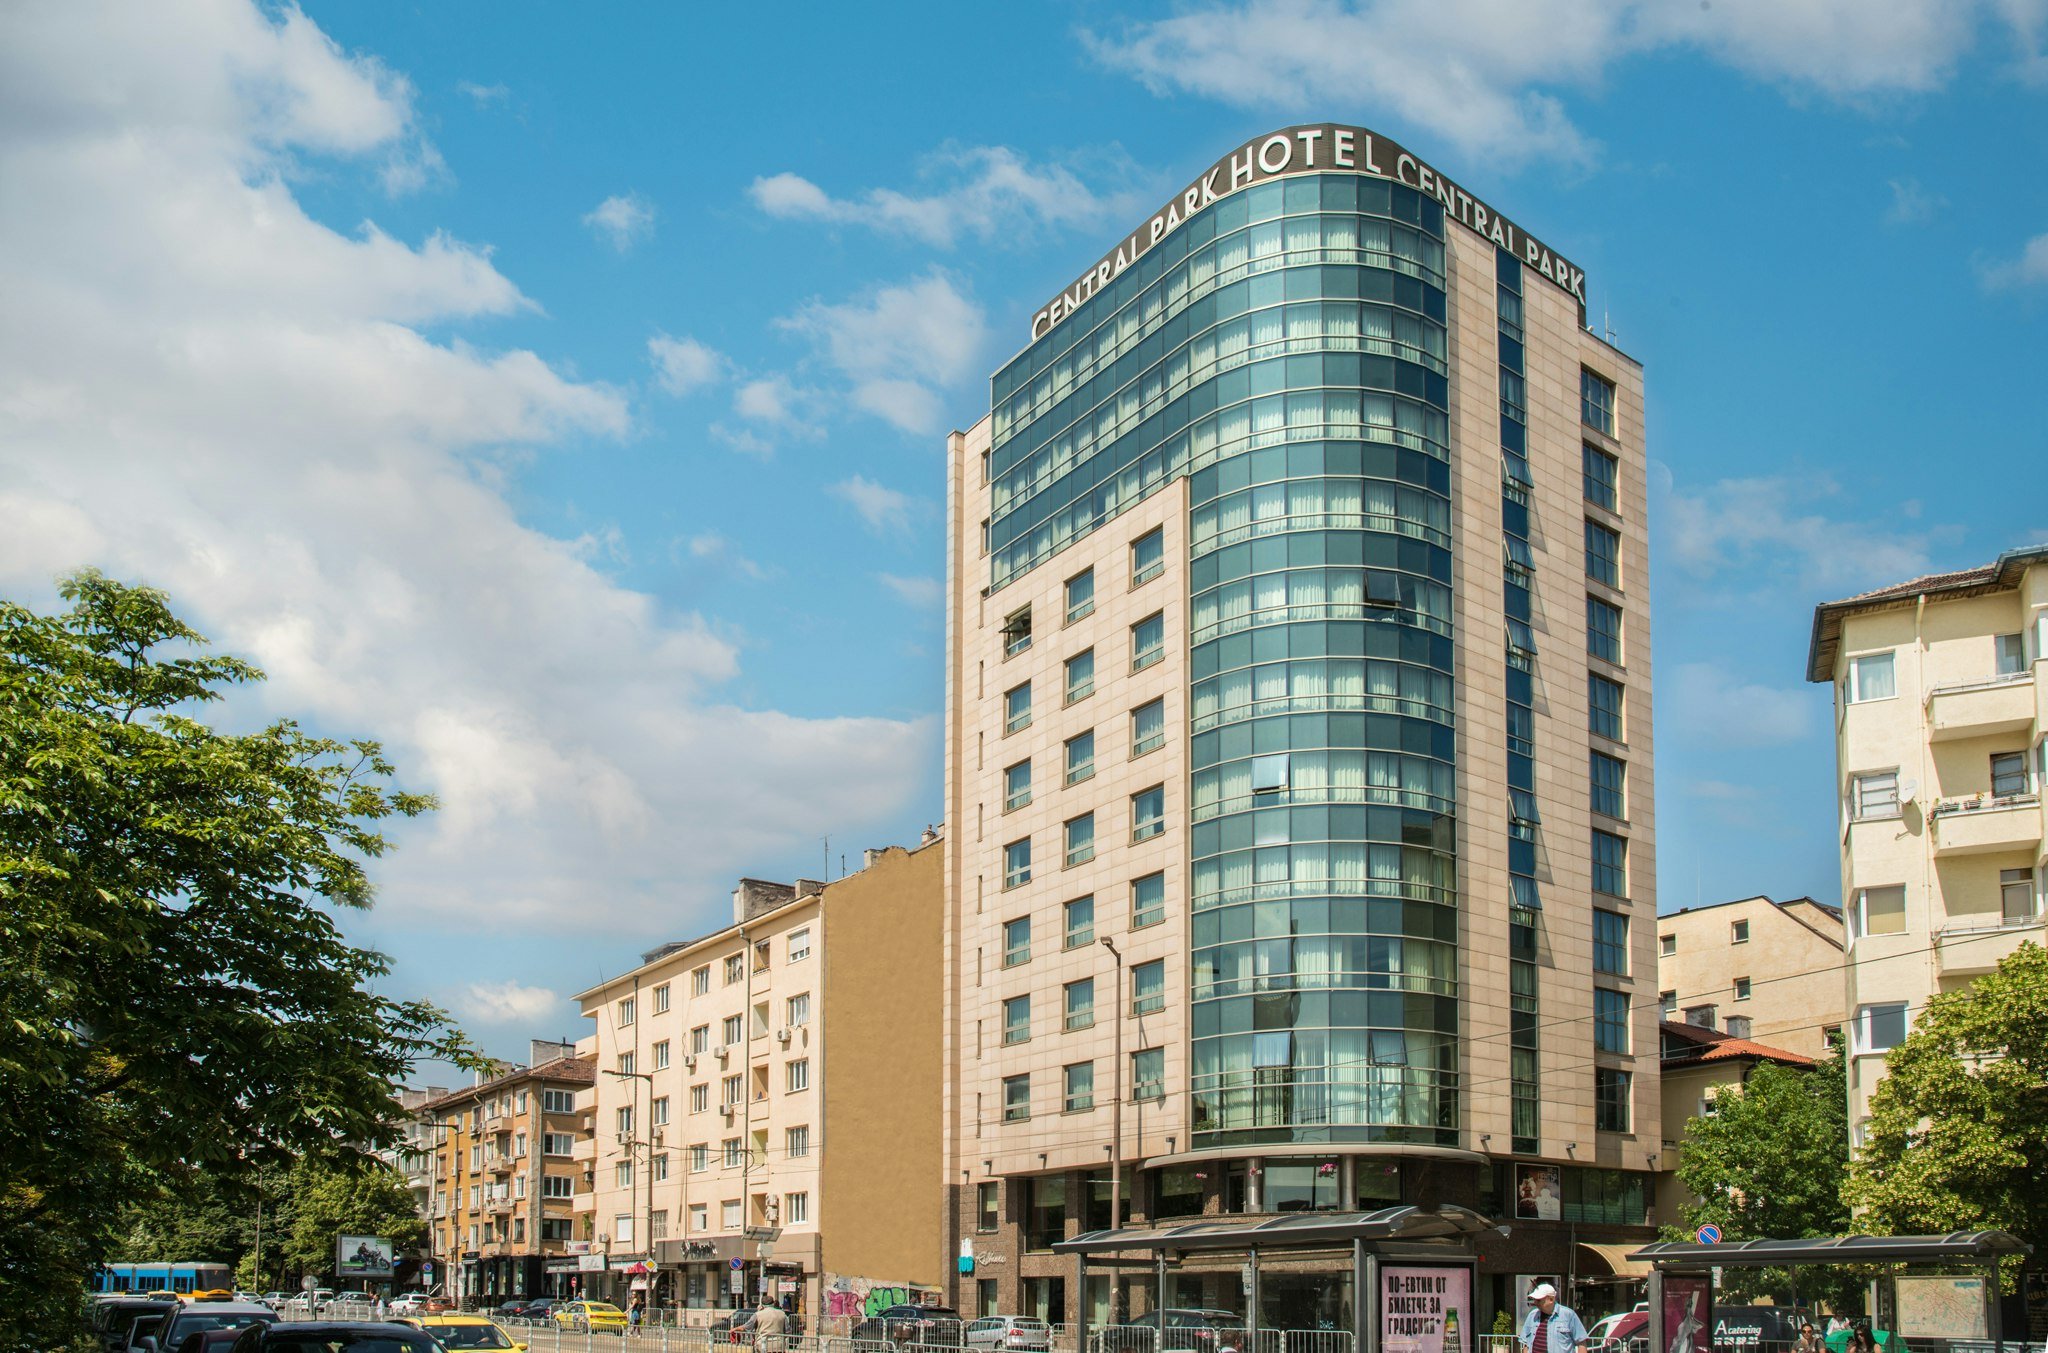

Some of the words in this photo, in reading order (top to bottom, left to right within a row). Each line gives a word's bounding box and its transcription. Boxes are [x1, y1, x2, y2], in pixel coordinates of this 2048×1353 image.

[1231, 130, 1381, 191] HOTEL
[1396, 153, 1513, 256] CENTRAL
[1526, 238, 1586, 306] PARK
[1031, 236, 1138, 342] CENTRAL
[1151, 167, 1220, 244] PARK
[1388, 1276, 1433, 1294] ПО-ЕВТИН
[1435, 1276, 1447, 1294] ОТ
[1388, 1297, 1427, 1314] БИЛЕТЧЕ
[1429, 1297, 1441, 1314] ЗА
[1714, 1319, 1728, 1335] A
[1727, 1324, 1762, 1336] catering
